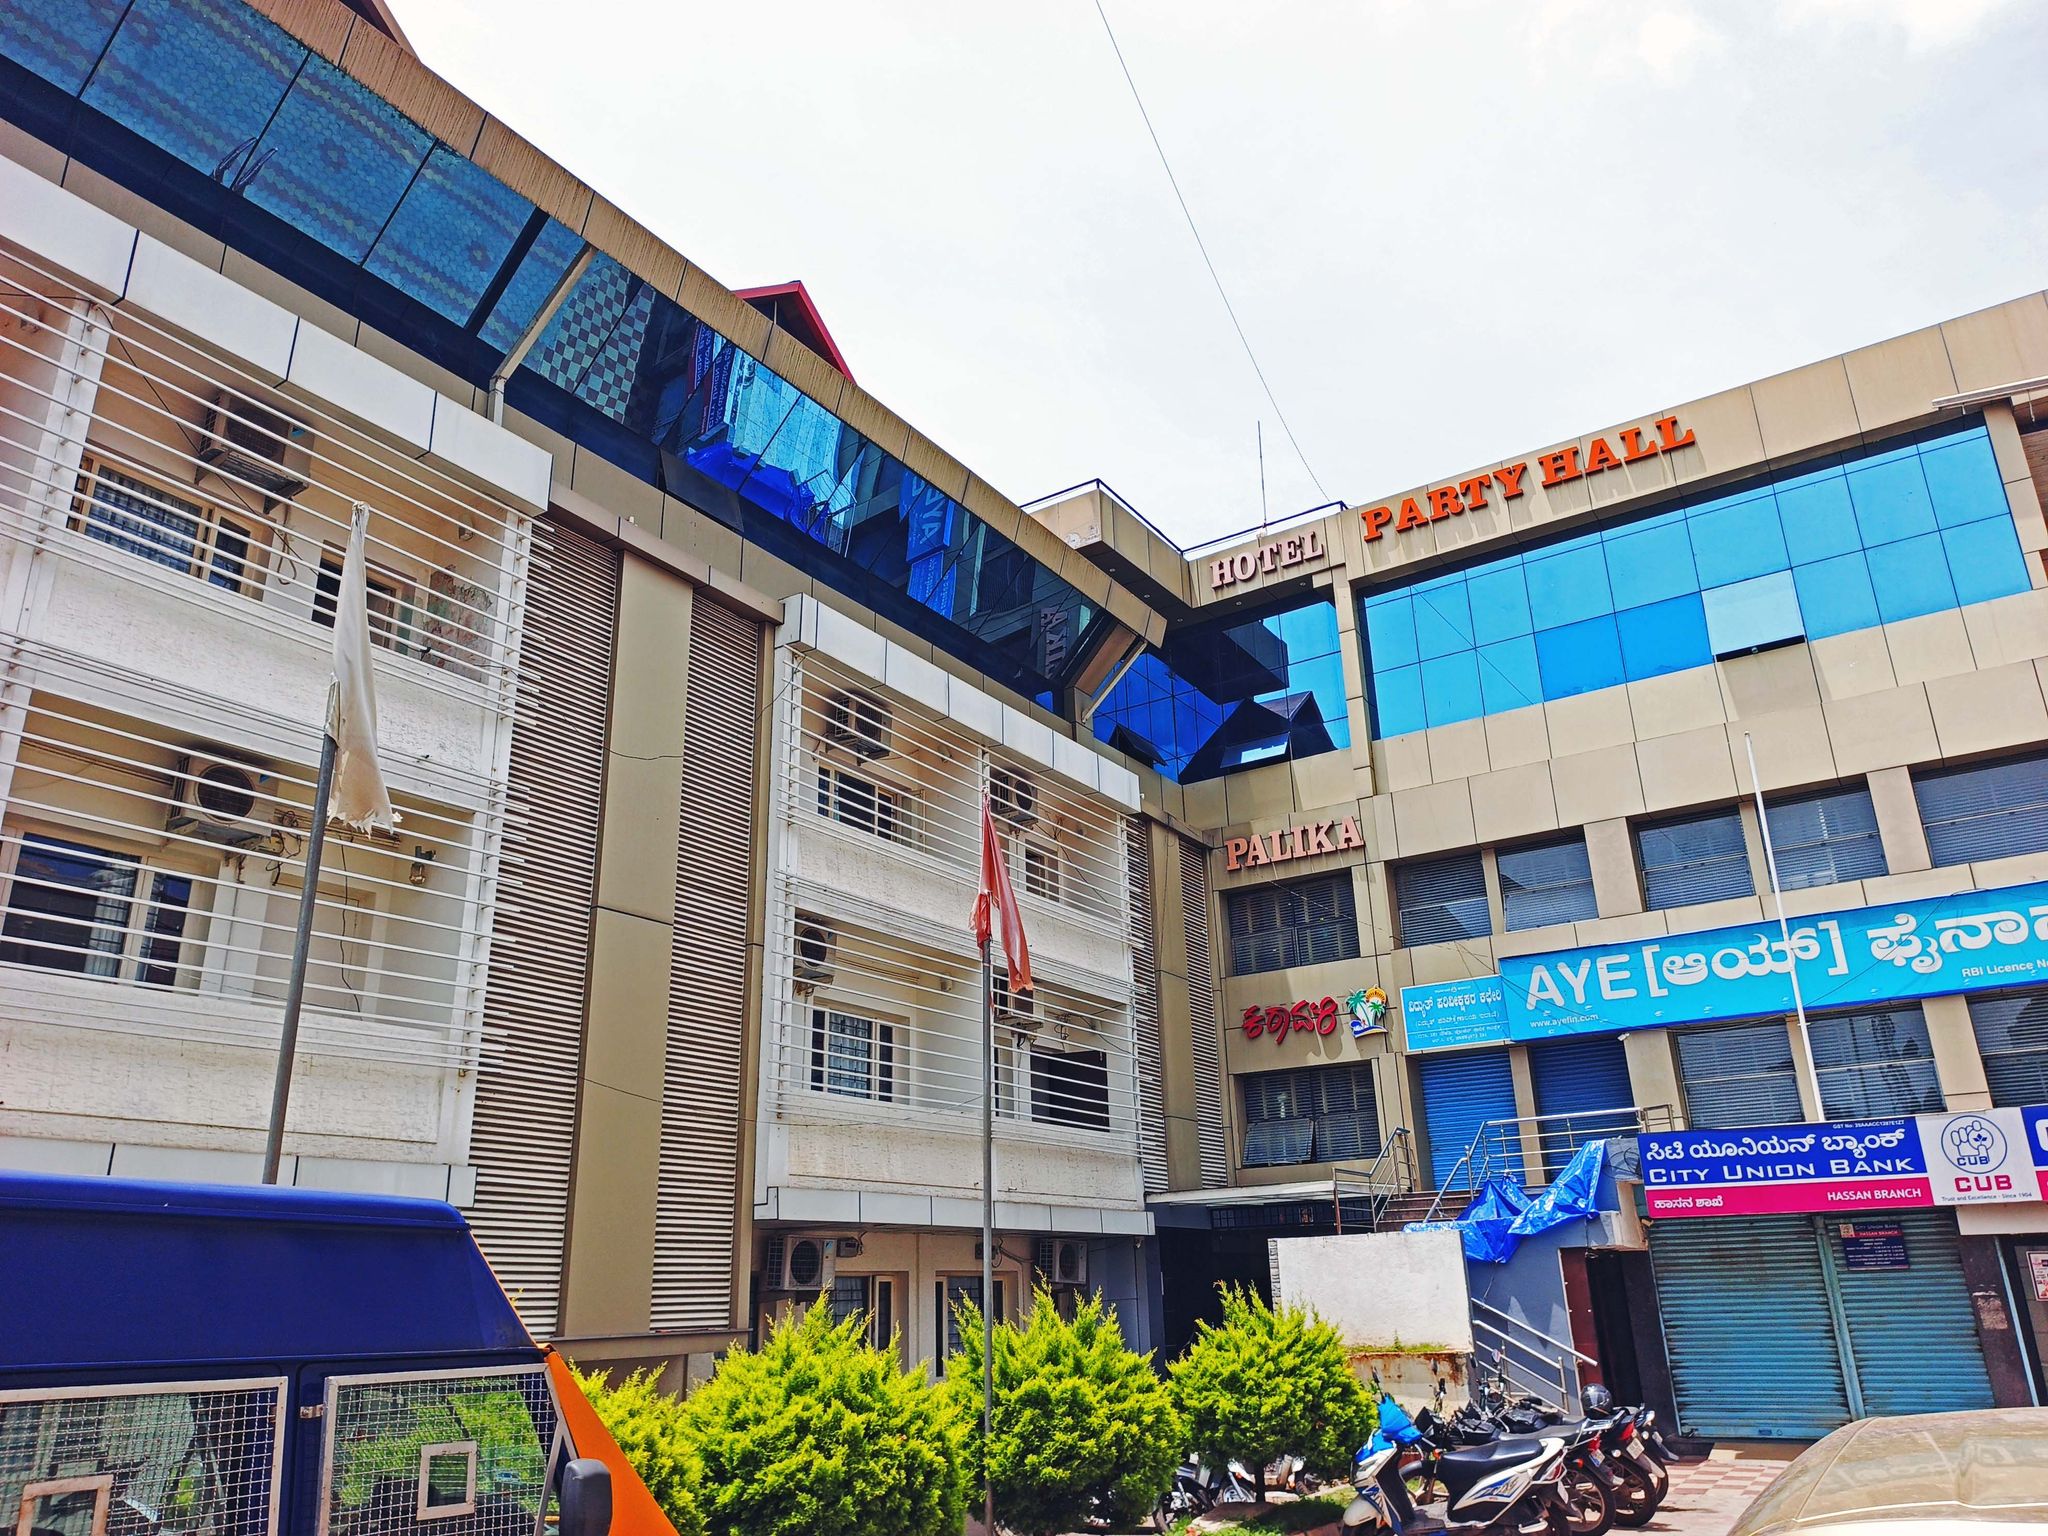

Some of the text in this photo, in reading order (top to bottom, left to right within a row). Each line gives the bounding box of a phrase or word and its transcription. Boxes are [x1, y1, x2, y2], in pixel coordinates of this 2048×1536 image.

[1361, 415, 1696, 542] PARTY HALL
[1210, 531, 1325, 589] HOTEL
[1225, 816, 1365, 871] PALIKA
[1961, 959, 2048, 977] RBI Licence N
[1526, 954, 1638, 1010] AYE
[1529, 1014, 1599, 1028] www.ayefin.com
[1646, 1128, 1906, 1161] ಸಿಟಿ ಯೂನಿಯನ್ ಬ್ಯಾಂಕ್
[1957, 1156, 1990, 1166] CUB
[1954, 1175, 2012, 1192] CUB
[1653, 1196, 1693, 1209] ಹಾಸನ
[1827, 1188, 1922, 1201] HASSAN BRANCH
